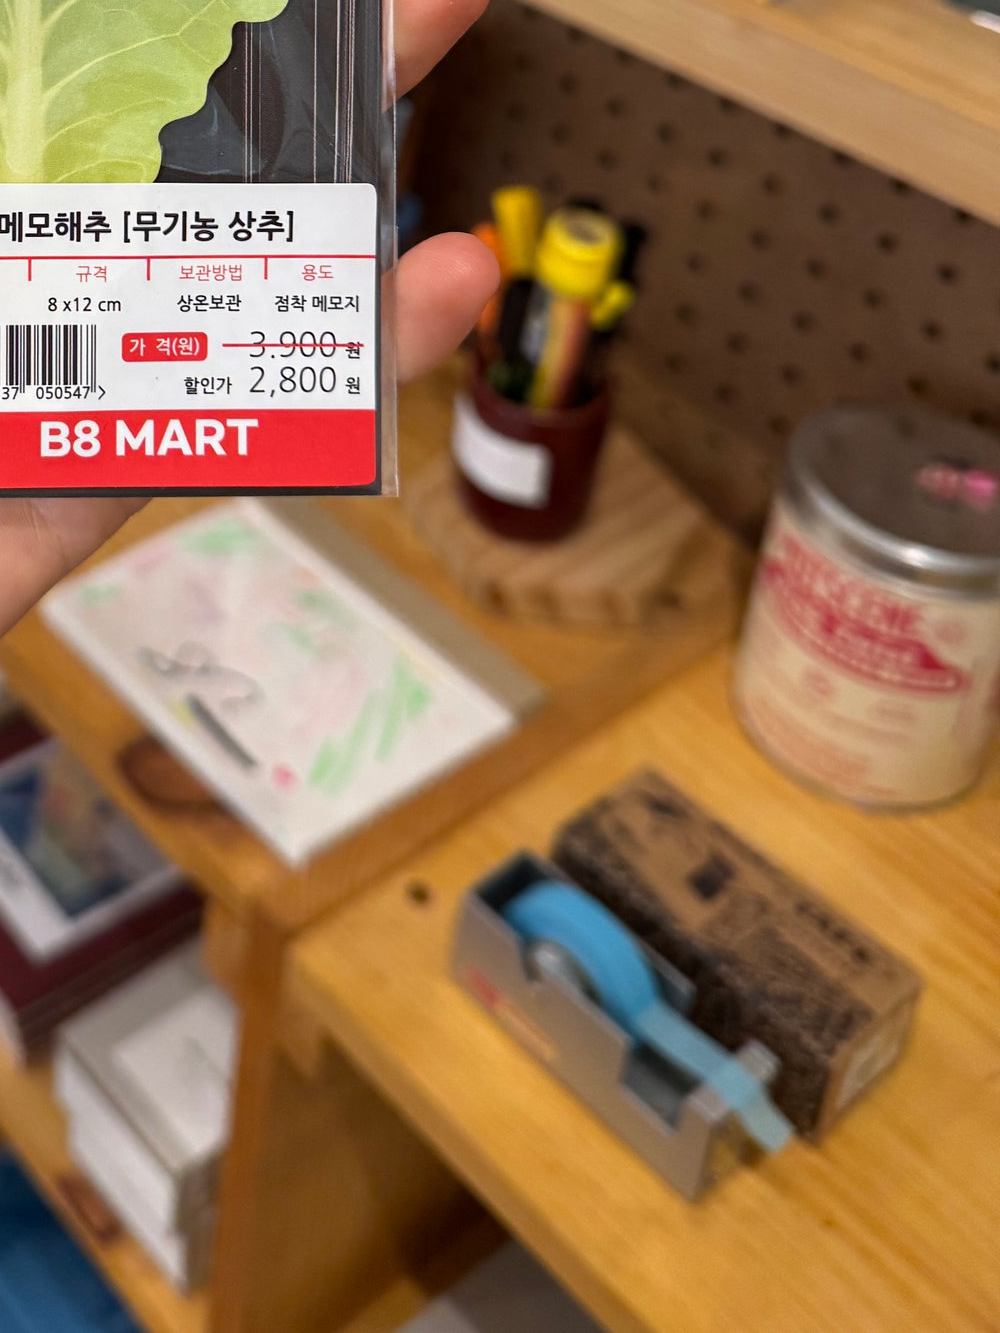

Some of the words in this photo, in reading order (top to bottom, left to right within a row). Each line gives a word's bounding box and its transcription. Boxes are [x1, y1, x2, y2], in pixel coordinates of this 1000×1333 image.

[123, 210, 219, 243] [무기농
[228, 210, 294, 243] 상추]
[75, 265, 108, 283] 규격
[179, 264, 243, 282] 보관방법
[301, 264, 334, 281] 용도
[47, 297, 58, 312] 8
[62, 297, 92, 312] x12
[98, 300, 122, 312] cm
[177, 294, 242, 313] 상온보관
[274, 295, 307, 313] 점착
[312, 294, 360, 313] 메모지
[344, 341, 361, 359] 원
[183, 376, 233, 394] 할인가
[249, 366, 337, 398] 2,800
[344, 376, 361, 395] 원
[39, 420, 102, 458] B8
[115, 418, 259, 457] MART
